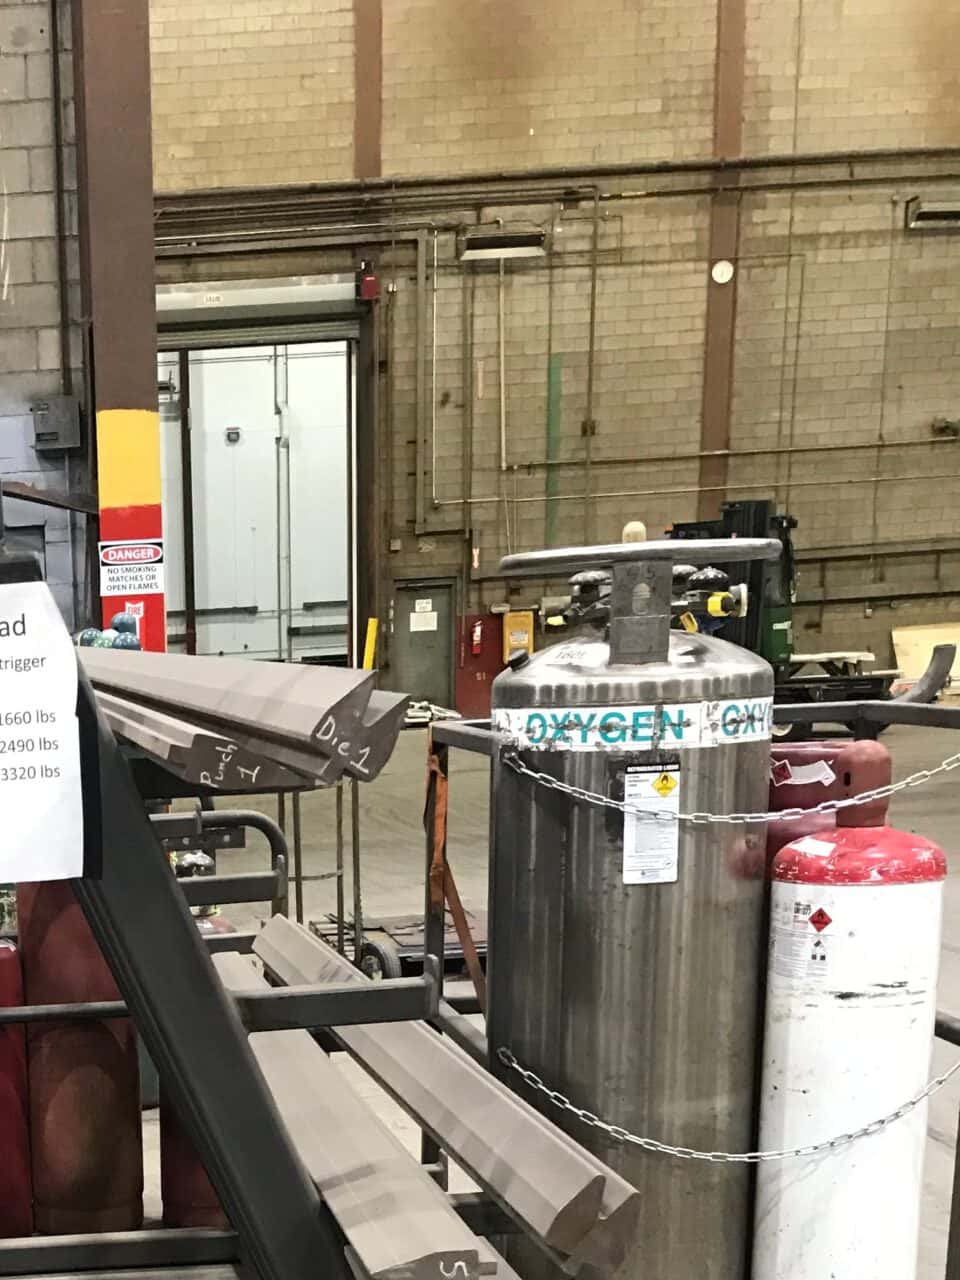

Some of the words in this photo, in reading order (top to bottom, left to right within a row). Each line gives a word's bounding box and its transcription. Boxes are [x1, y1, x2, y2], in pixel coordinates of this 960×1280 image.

[108, 549, 154, 561] DANGER
[107, 567, 119, 575] NO
[121, 566, 157, 574] SMOKING
[108, 575, 144, 583] MATCHES
[106, 584, 127, 592] OPEN
[128, 582, 159, 591] FLAMES
[127, 606, 142, 615] FIRE
[36, 709, 57, 724] lbs
[526, 709, 684, 744] OXYGEN
[0, 738, 35, 754] 2490
[39, 737, 59, 751] lbs
[200, 743, 239, 788] Punch
[237, 764, 261, 783] 1
[350, 747, 371, 774] 1
[1, 766, 37, 781] 3320
[40, 765, 61, 779] lbs
